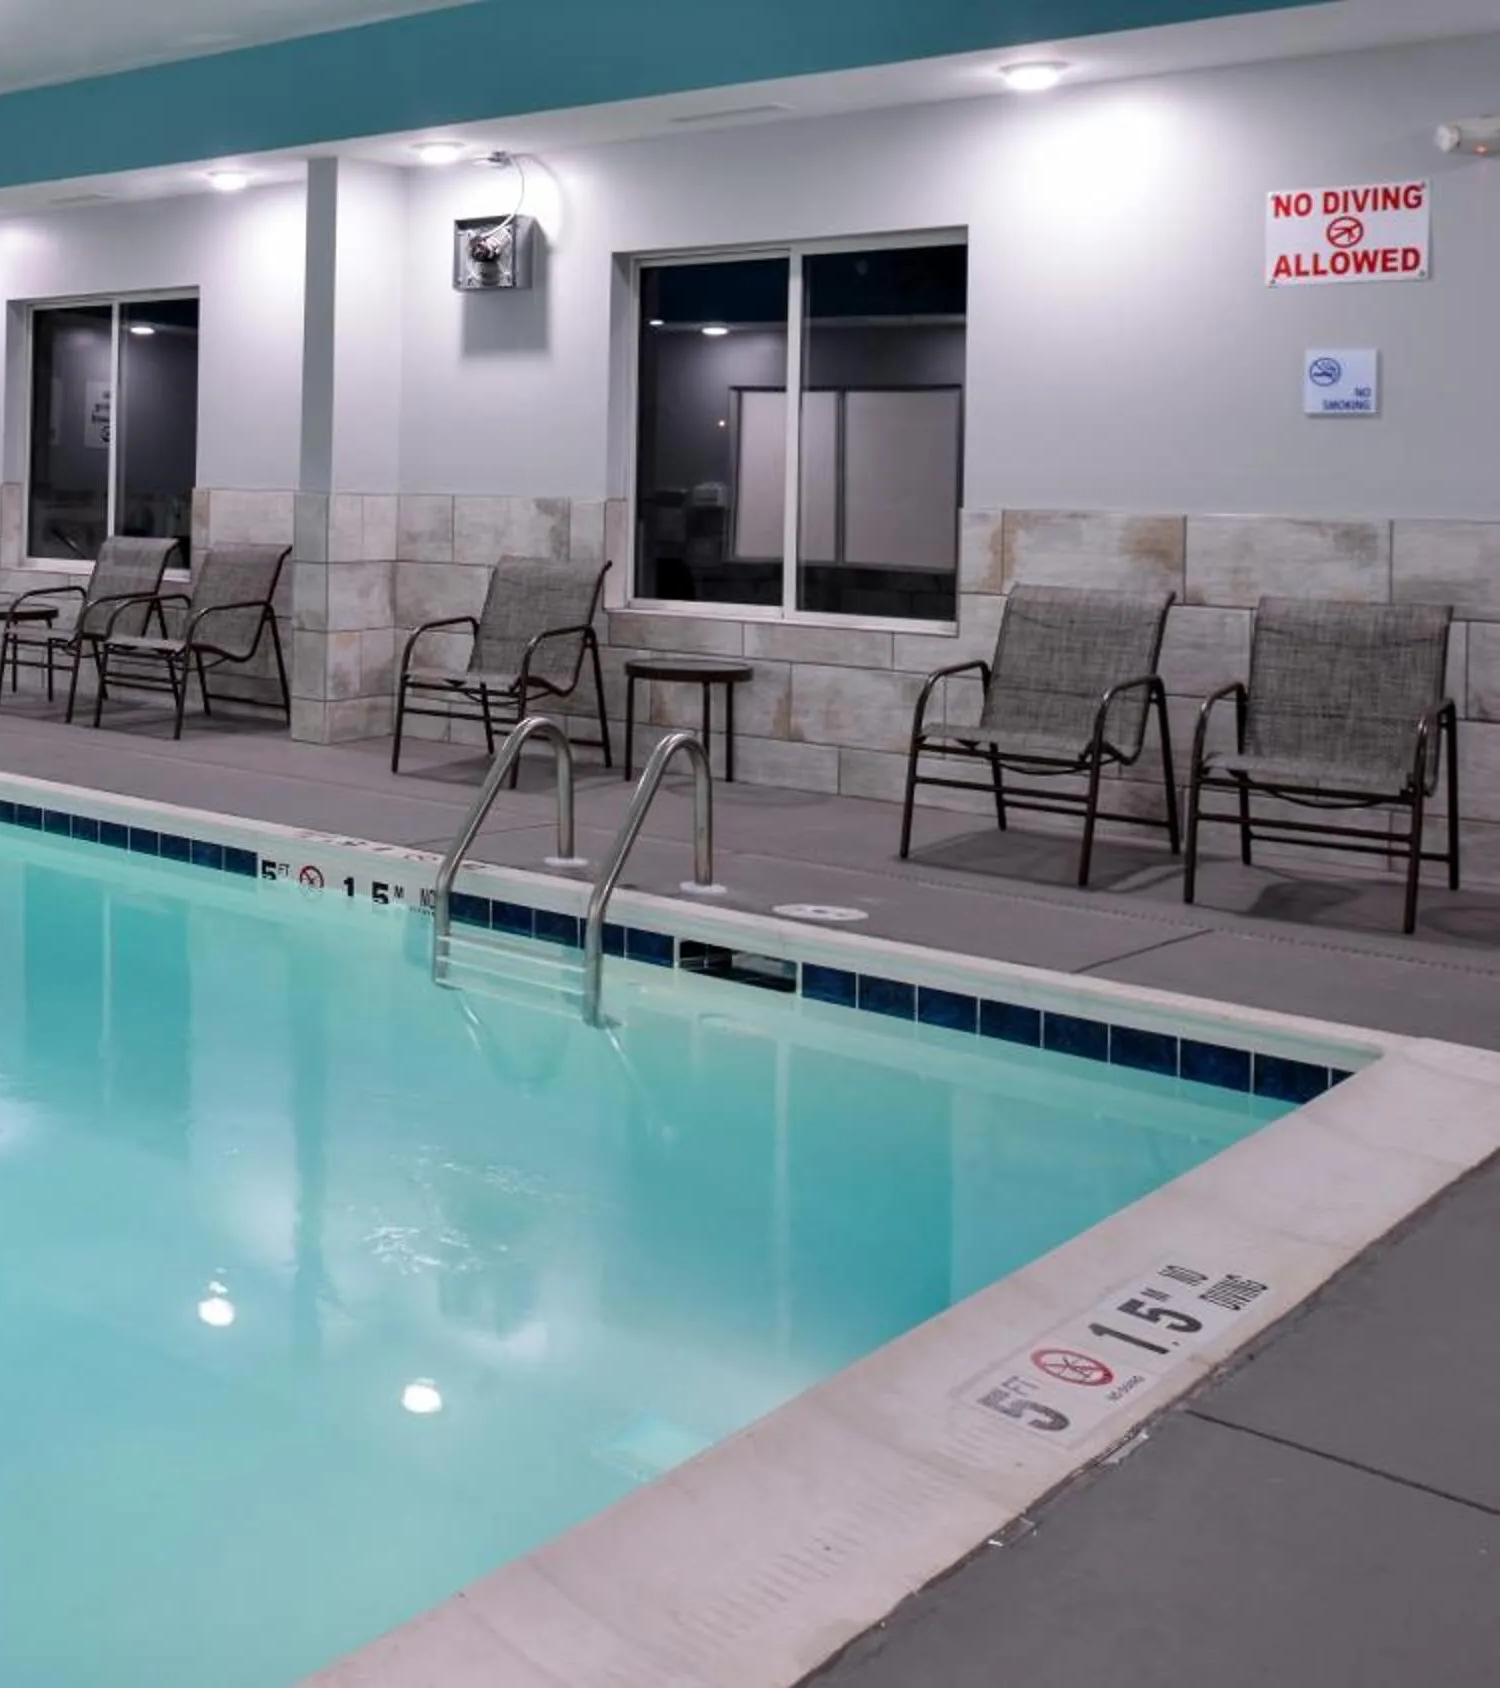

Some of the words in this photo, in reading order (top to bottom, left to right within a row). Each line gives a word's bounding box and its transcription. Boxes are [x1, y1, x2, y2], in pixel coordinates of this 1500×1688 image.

[1273, 192, 1312, 219] NO
[1322, 184, 1423, 215] DIVING
[1273, 247, 1421, 279] ALLOWED
[1353, 387, 1372, 398] NO
